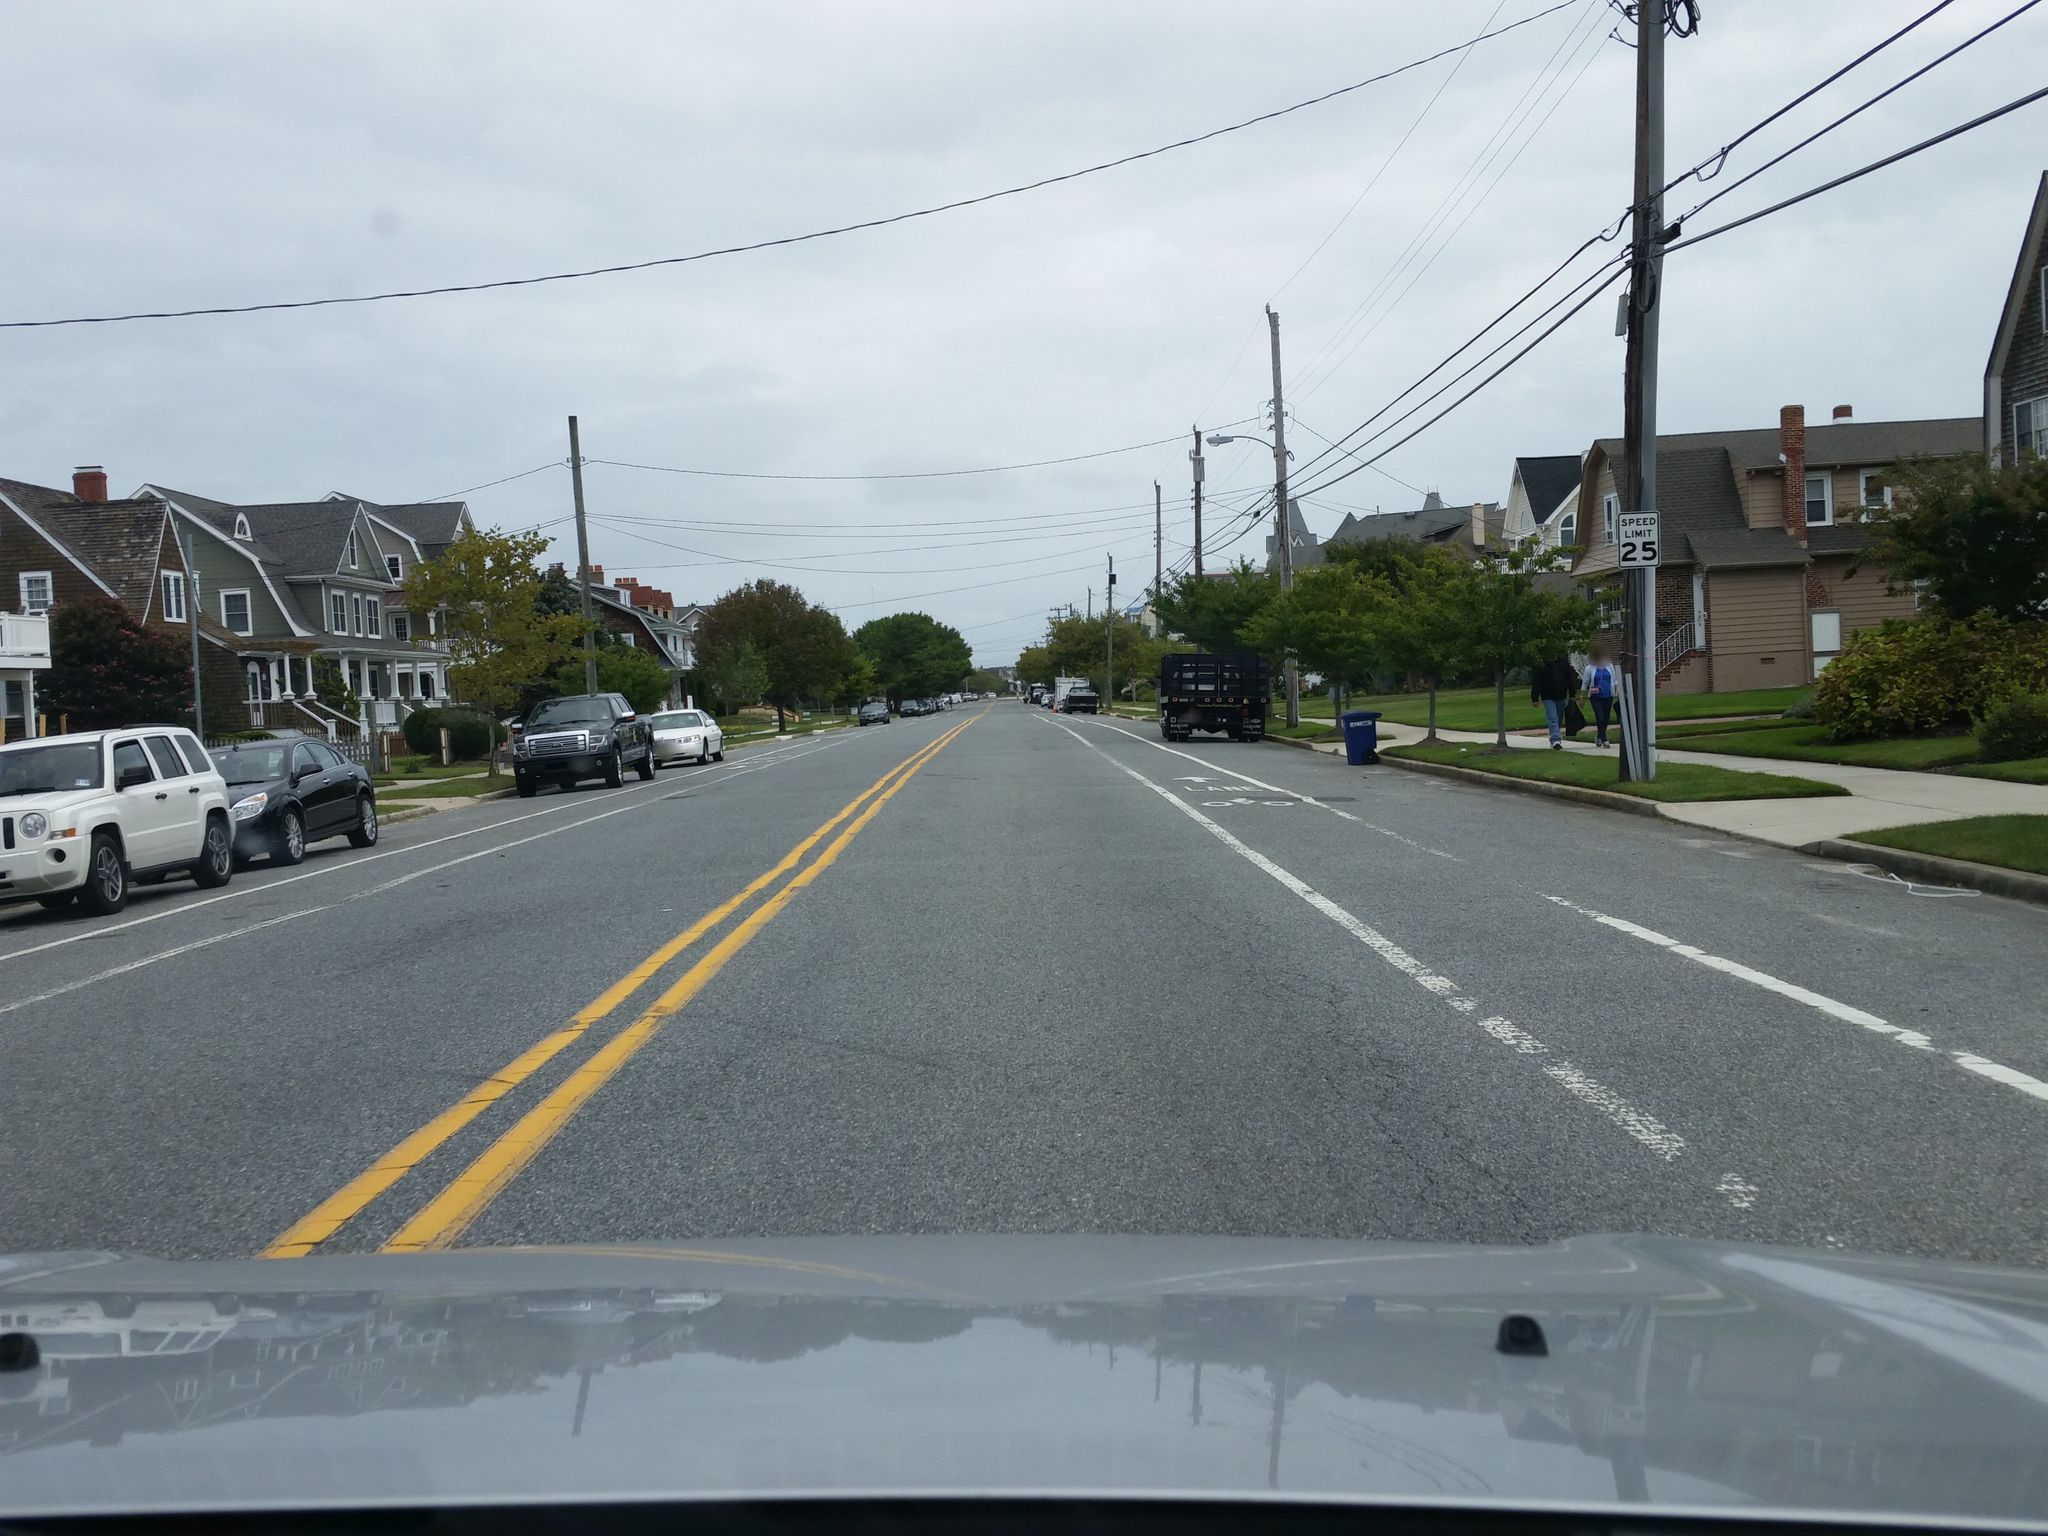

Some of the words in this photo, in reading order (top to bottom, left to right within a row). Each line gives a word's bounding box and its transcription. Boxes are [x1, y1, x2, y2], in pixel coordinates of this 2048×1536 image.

[1621, 517, 1656, 527] SPEED
[1625, 530, 1653, 538] LIMIT
[1621, 541, 1657, 562] 25
